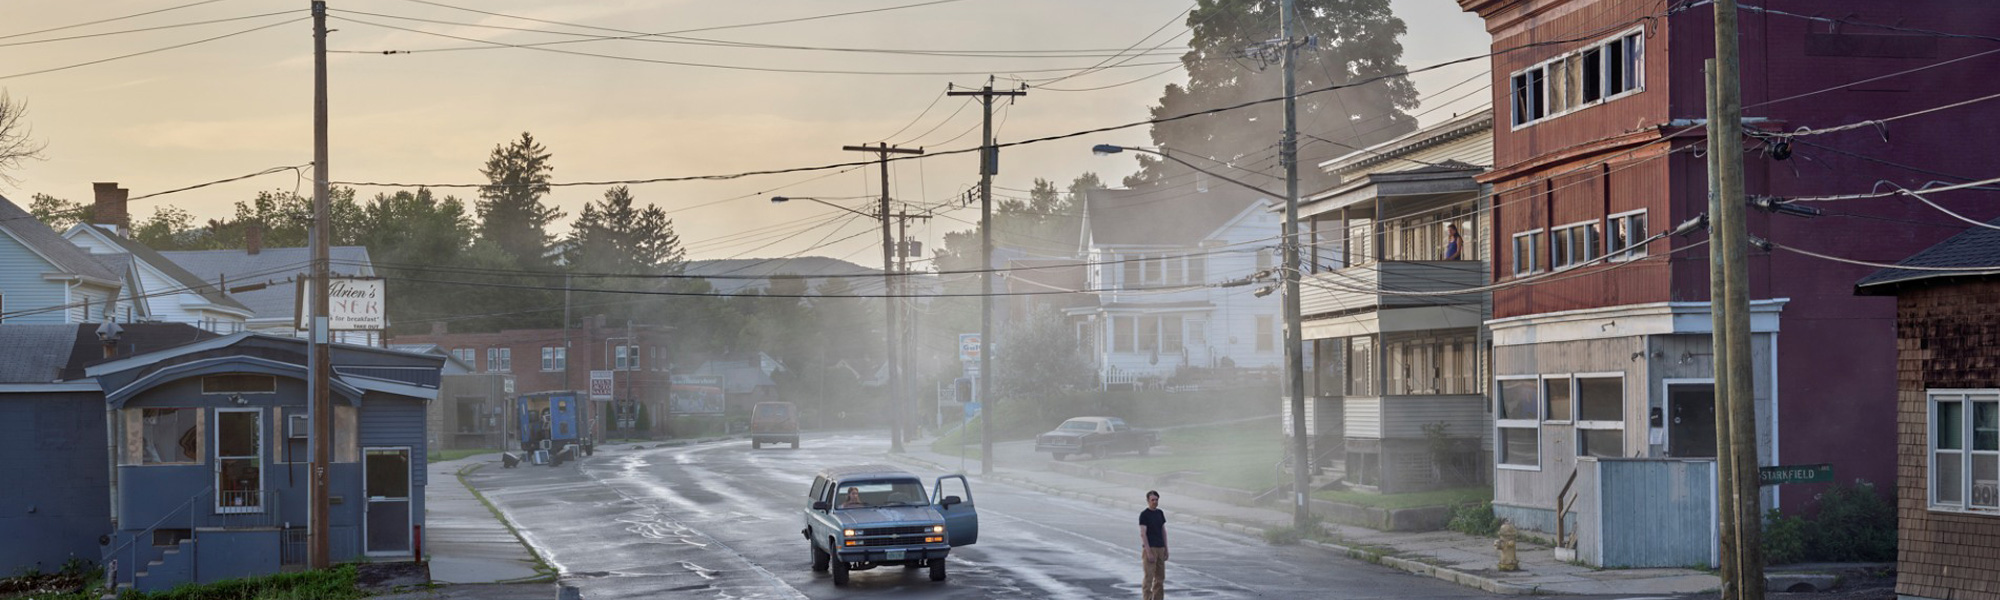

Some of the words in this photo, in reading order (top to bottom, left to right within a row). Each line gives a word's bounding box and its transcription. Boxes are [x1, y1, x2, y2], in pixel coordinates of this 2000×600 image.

[328, 280, 377, 299] Adrien's
[333, 299, 378, 314] NER
[1761, 469, 1815, 480] STARKFIELD
